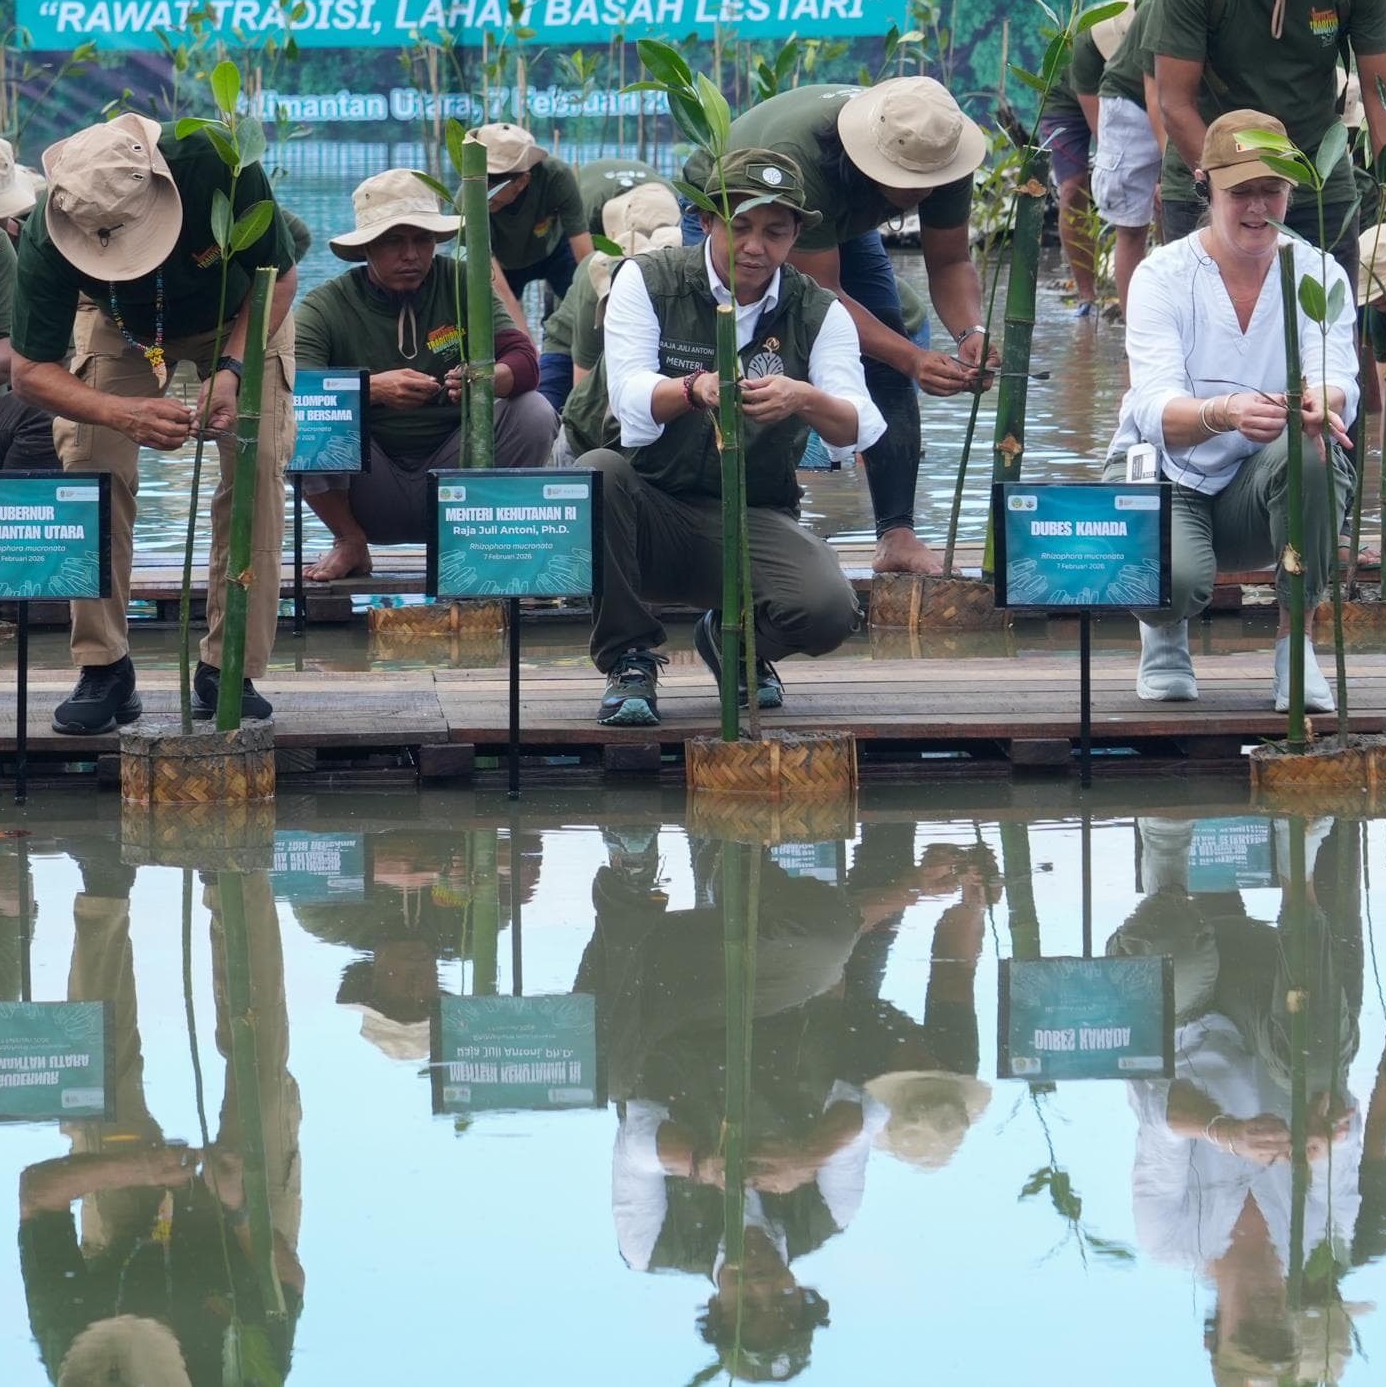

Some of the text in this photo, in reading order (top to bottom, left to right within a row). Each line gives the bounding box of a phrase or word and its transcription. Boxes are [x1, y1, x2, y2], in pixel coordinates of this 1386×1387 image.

[677, 344, 690, 352] JULI
[691, 347, 715, 356] ANTONI
[666, 356, 703, 370] MENTERI
[307, 410, 353, 421] BERSAMA
[445, 506, 576, 521] MENTERI KEHUTANAN RI
[44, 525, 84, 540] UTARA
[453, 525, 570, 536] Raja Juli Antoni, Ph.D.
[1030, 521, 1127, 536] DUBES KANADA
[469, 542, 511, 552] Rhizophora
